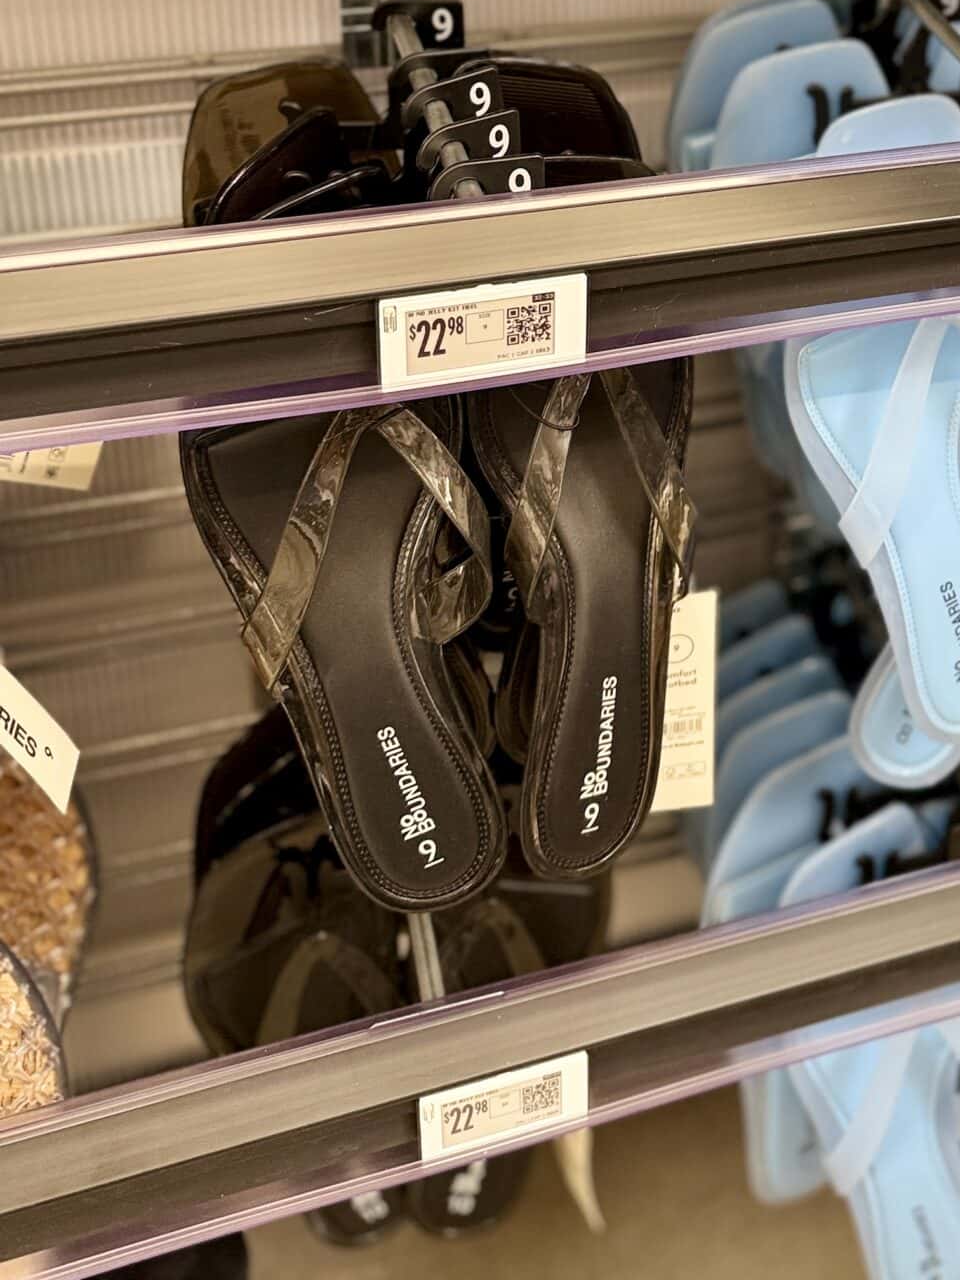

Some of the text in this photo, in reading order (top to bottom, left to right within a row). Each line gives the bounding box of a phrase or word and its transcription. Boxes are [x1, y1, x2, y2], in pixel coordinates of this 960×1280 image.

[431, 7, 454, 41] 9
[469, 81, 492, 117] 9
[488, 124, 511, 158] 9
[594, 675, 618, 795] BOUNDARIES
[377, 725, 436, 835] BOUNDARIES
[580, 771, 597, 800] NO
[400, 814, 420, 841] NO
